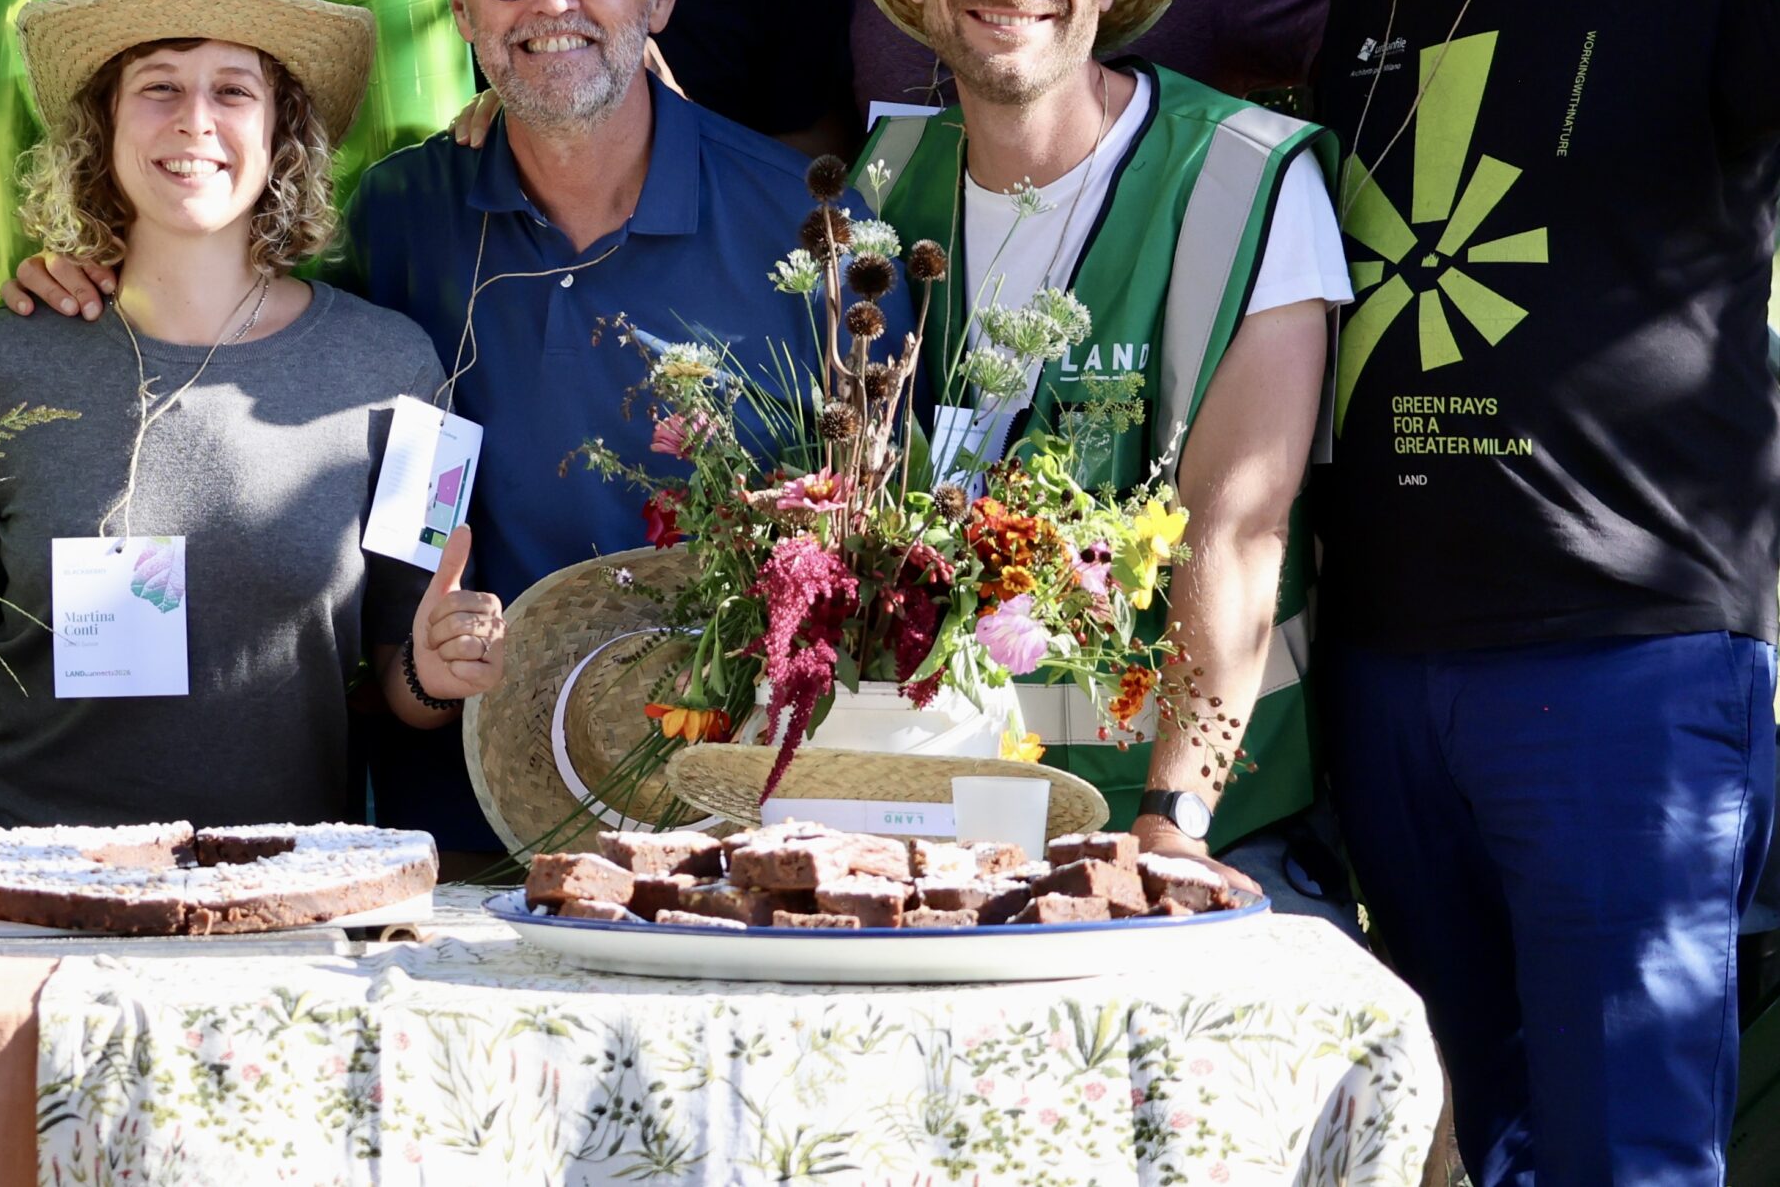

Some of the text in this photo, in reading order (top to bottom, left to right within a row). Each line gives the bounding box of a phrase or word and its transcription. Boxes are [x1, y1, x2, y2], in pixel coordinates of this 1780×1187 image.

[1556, 30, 1597, 157] WORKINGWITHNATURE
[1060, 342, 1150, 371] LAND
[1392, 396, 1498, 415] GREEN RAYS
[1393, 416, 1440, 434] FOR A
[1394, 436, 1532, 456] GREATER MILAN
[1398, 474, 1428, 486] LAND
[64, 610, 115, 623] Martina
[64, 624, 98, 636] Conti
[884, 814, 924, 824] LAND
